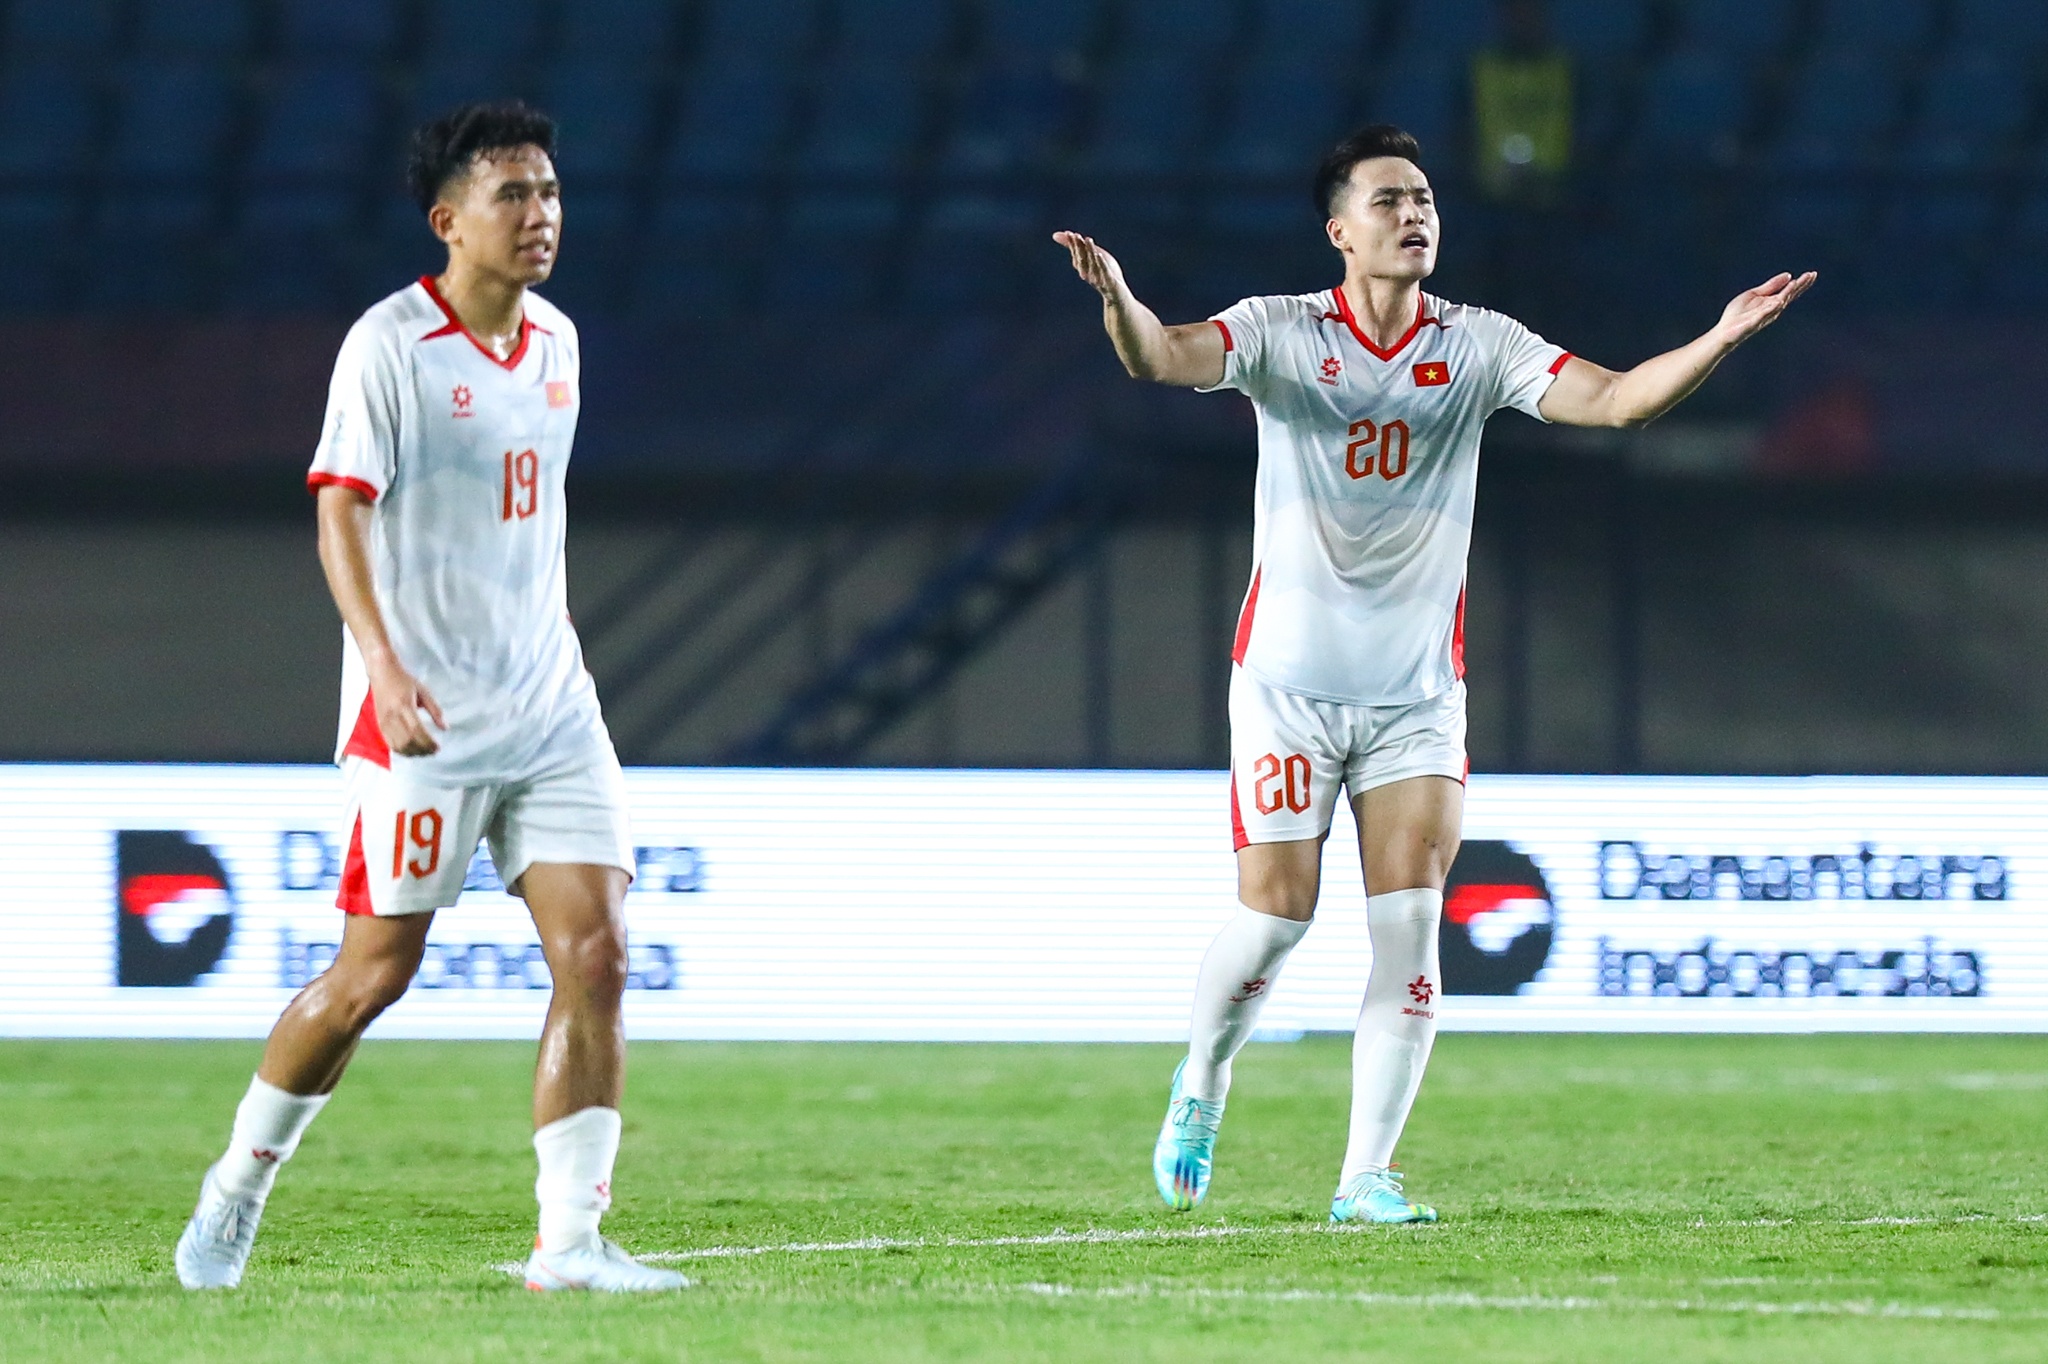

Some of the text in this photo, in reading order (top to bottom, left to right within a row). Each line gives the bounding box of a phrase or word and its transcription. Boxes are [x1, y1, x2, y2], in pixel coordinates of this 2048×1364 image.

[1345, 417, 1410, 482] 20
[503, 448, 538, 522] 19
[1253, 752, 1312, 816] 20
[393, 808, 443, 880] 19
[1599, 841, 2006, 901] Danantara
[1600, 936, 1981, 997] Indonesia
